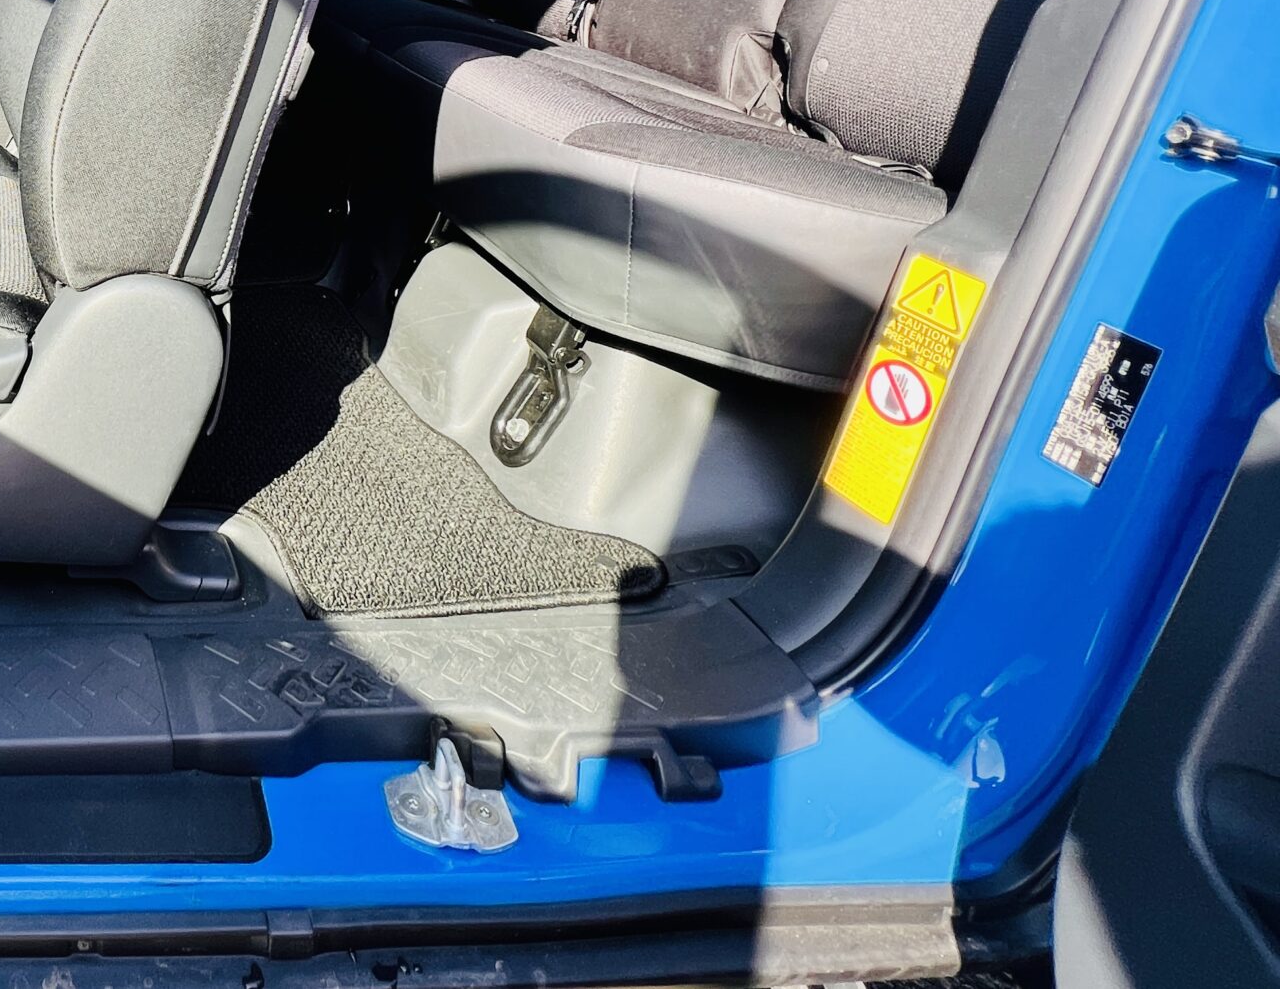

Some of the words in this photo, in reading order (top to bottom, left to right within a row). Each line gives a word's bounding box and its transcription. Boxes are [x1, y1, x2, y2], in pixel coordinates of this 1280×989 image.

[883, 327, 952, 369] PRECAUCION
[886, 319, 955, 358] ATTENTION
[897, 313, 950, 344] CAUTION
